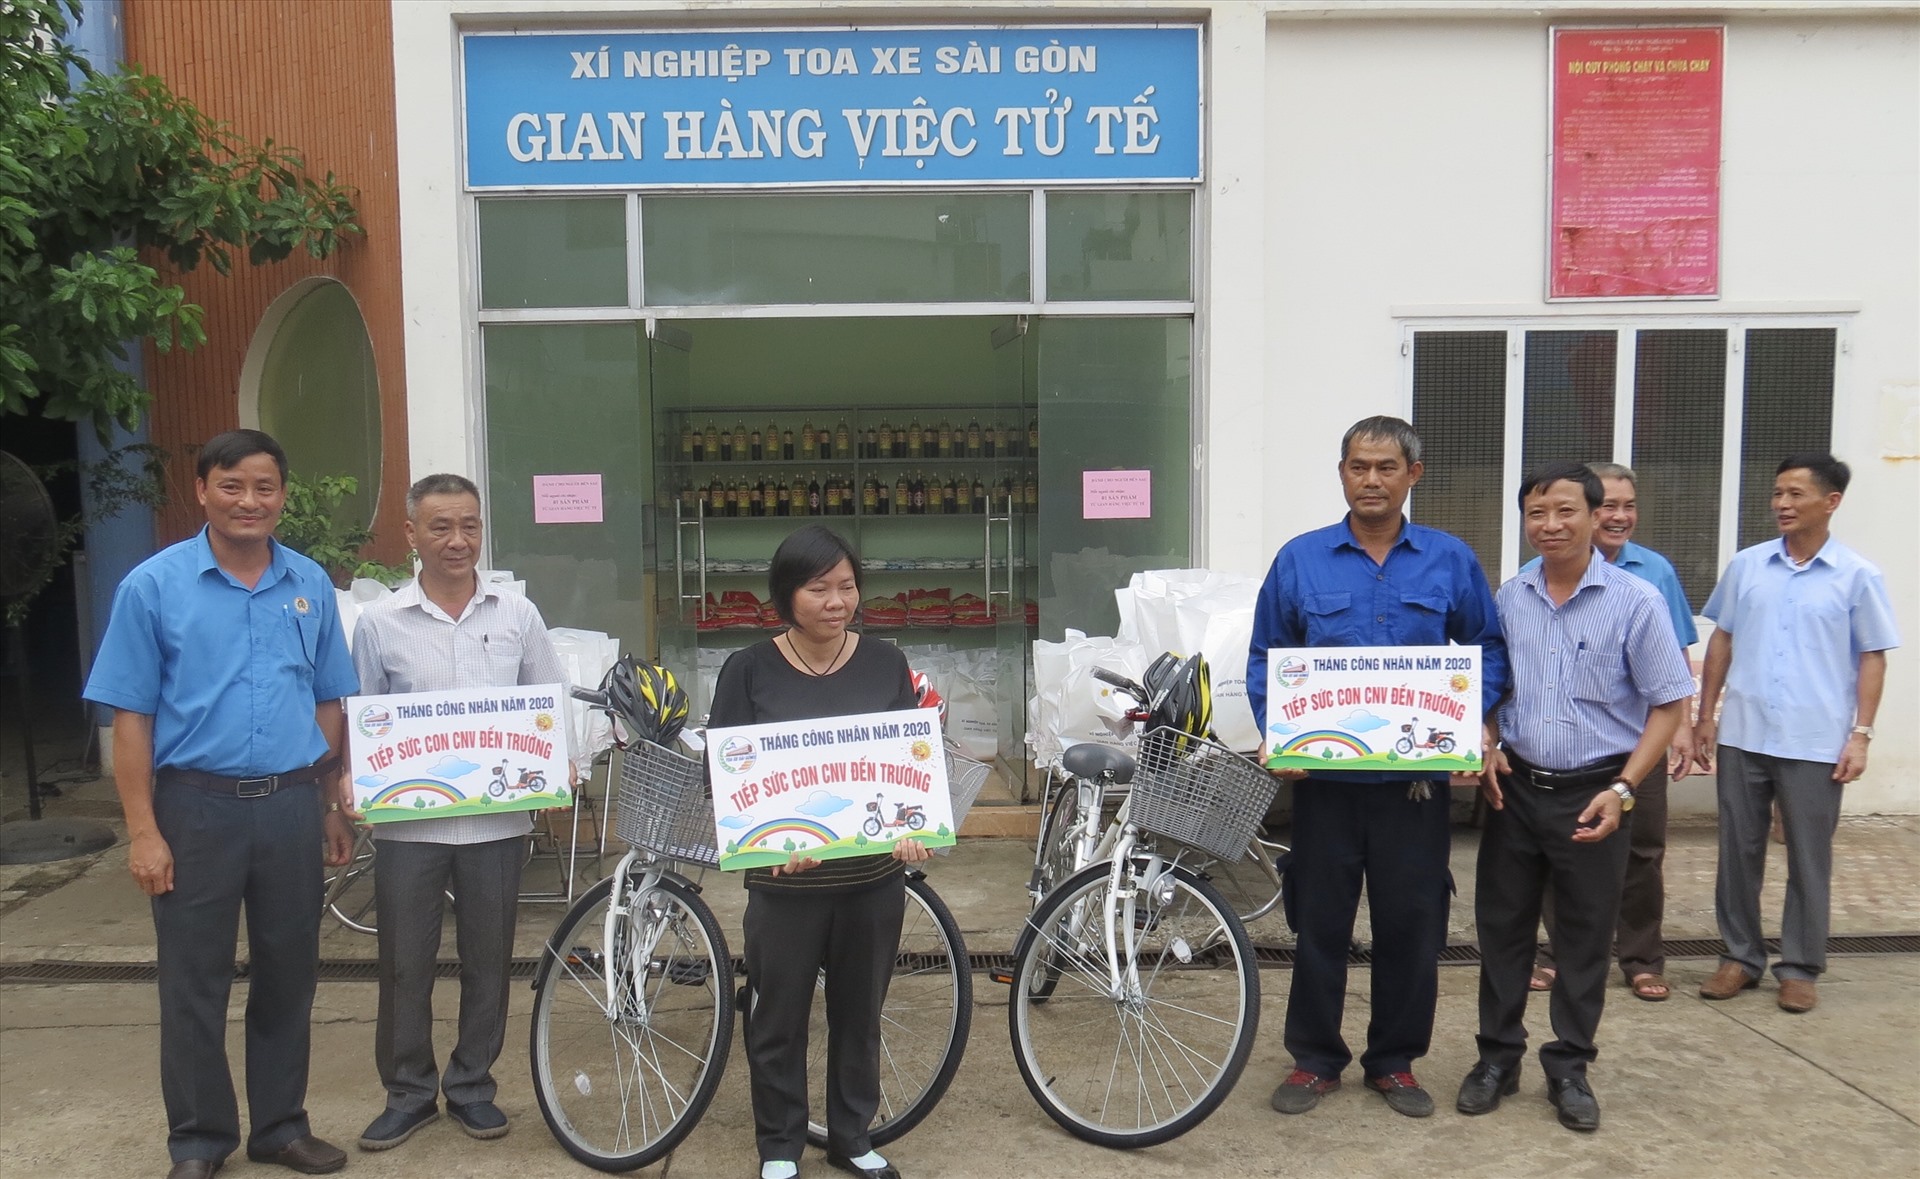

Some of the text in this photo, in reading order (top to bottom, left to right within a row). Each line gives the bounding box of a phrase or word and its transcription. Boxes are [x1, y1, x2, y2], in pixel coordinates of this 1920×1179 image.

[570, 39, 1097, 82] XÍ NGHIỆP TOA XE SÀI GÒN
[506, 85, 1161, 169] GIAN HÀNG VIỆC TỬ TẾ
[1313, 655, 1472, 671] THÁNG CÔNG NHÂN NĂM 2020
[397, 696, 554, 720] THÁNG CÔNG NHÂN NĂM 2020
[1282, 682, 1466, 722] TIẾP SỨC CON CNV ĐẾN TRƯỜNG
[367, 725, 553, 773] TIẾP SỨC CON CNV ĐẾN TRƯỜNG
[760, 721, 931, 752] THÁNG CÔNG NHÂN NĂM 2020
[730, 755, 931, 812] TIẾP SỨC CON CNV ĐẾN TRƯỜNG
